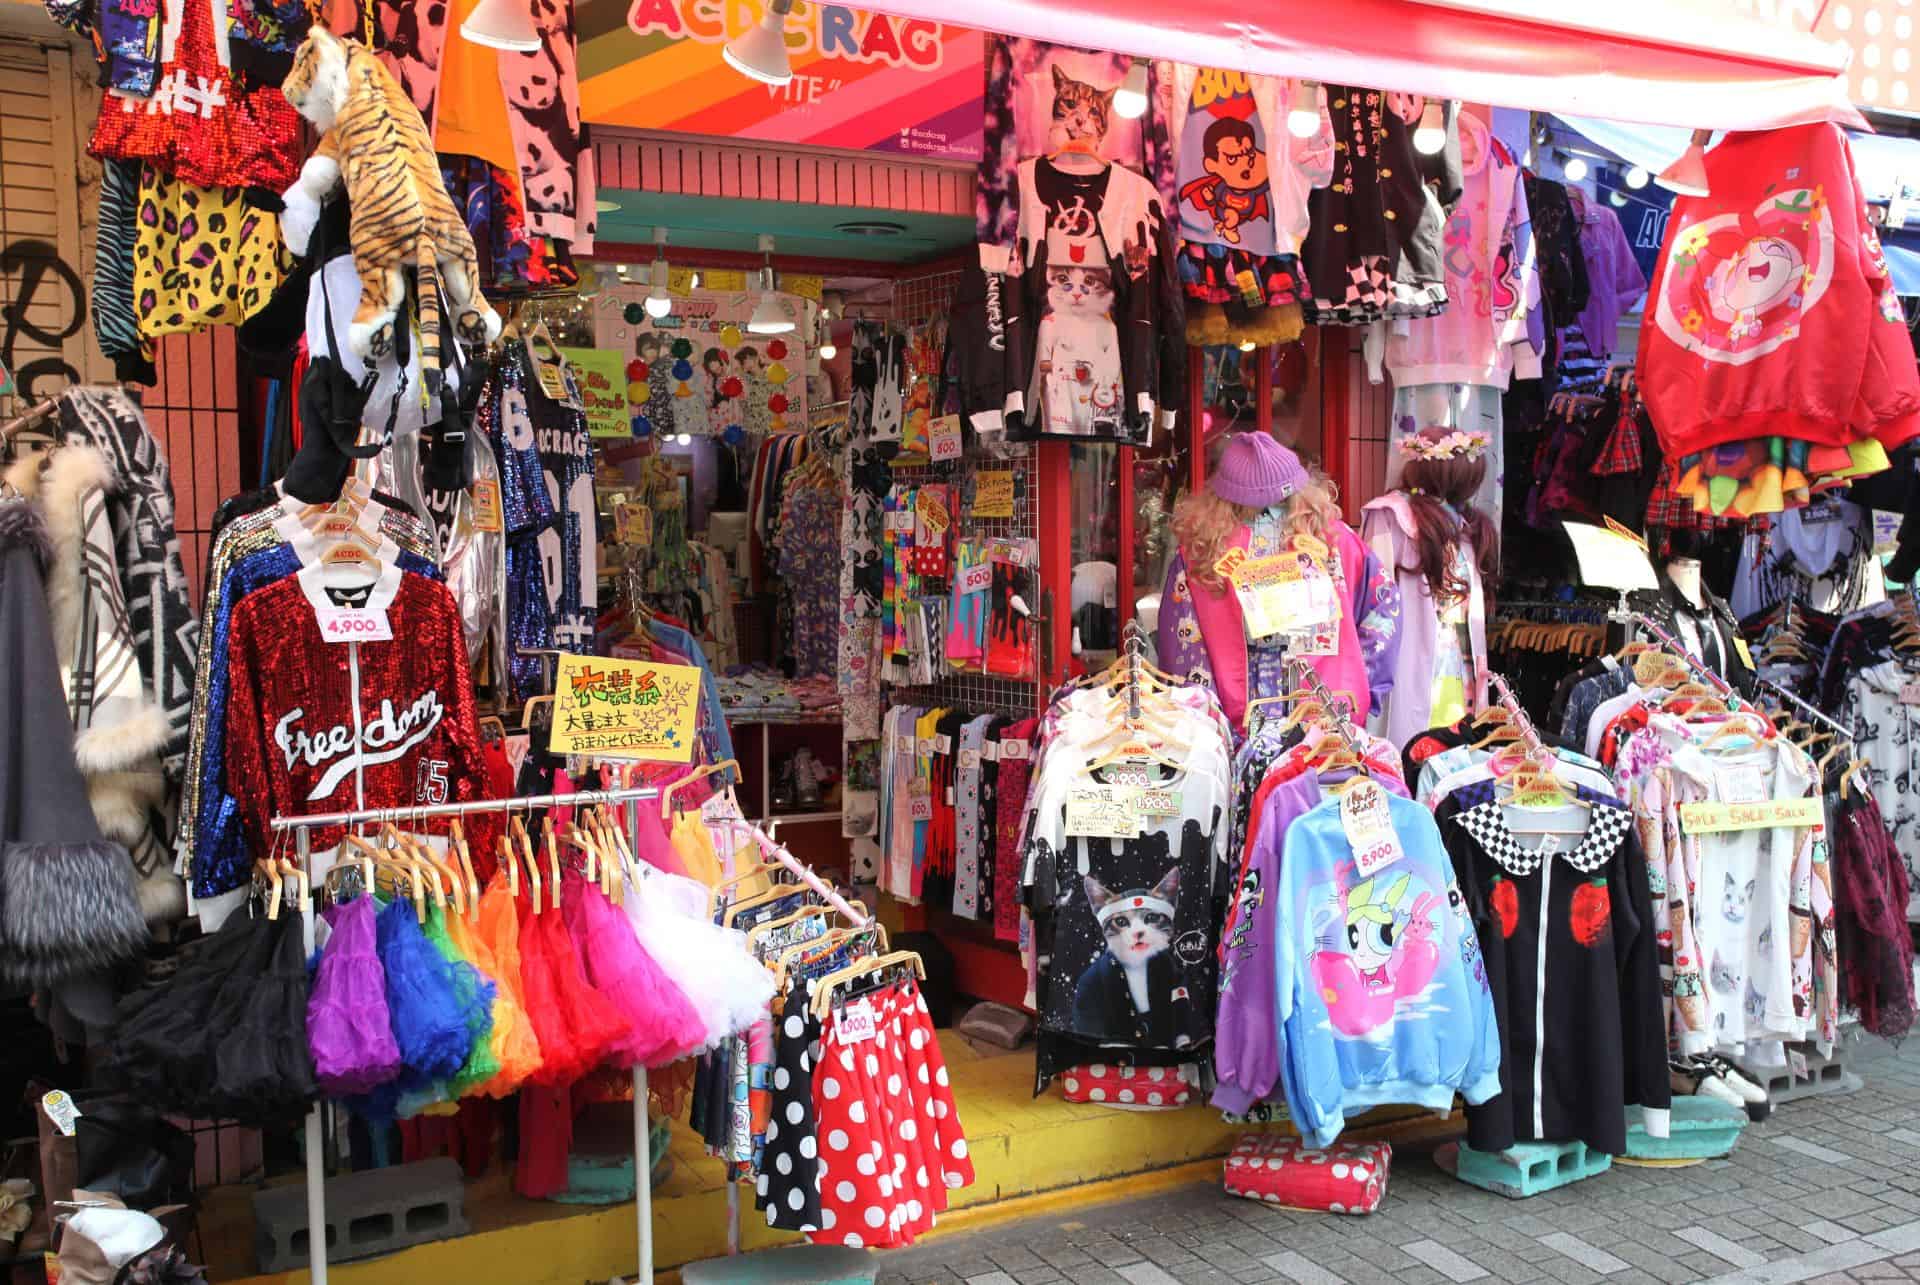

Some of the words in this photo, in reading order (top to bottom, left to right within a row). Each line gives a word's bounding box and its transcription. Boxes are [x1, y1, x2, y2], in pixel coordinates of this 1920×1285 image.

[334, 550, 362, 559] ACDC
[327, 619, 377, 635] 4,900
[571, 665, 662, 707] 衣装系
[274, 690, 444, 770] Freedom
[565, 710, 629, 731] 大量注文
[571, 730, 666, 751] おまかせください
[415, 759, 449, 804] 05
[1361, 843, 1393, 867] 5,900
